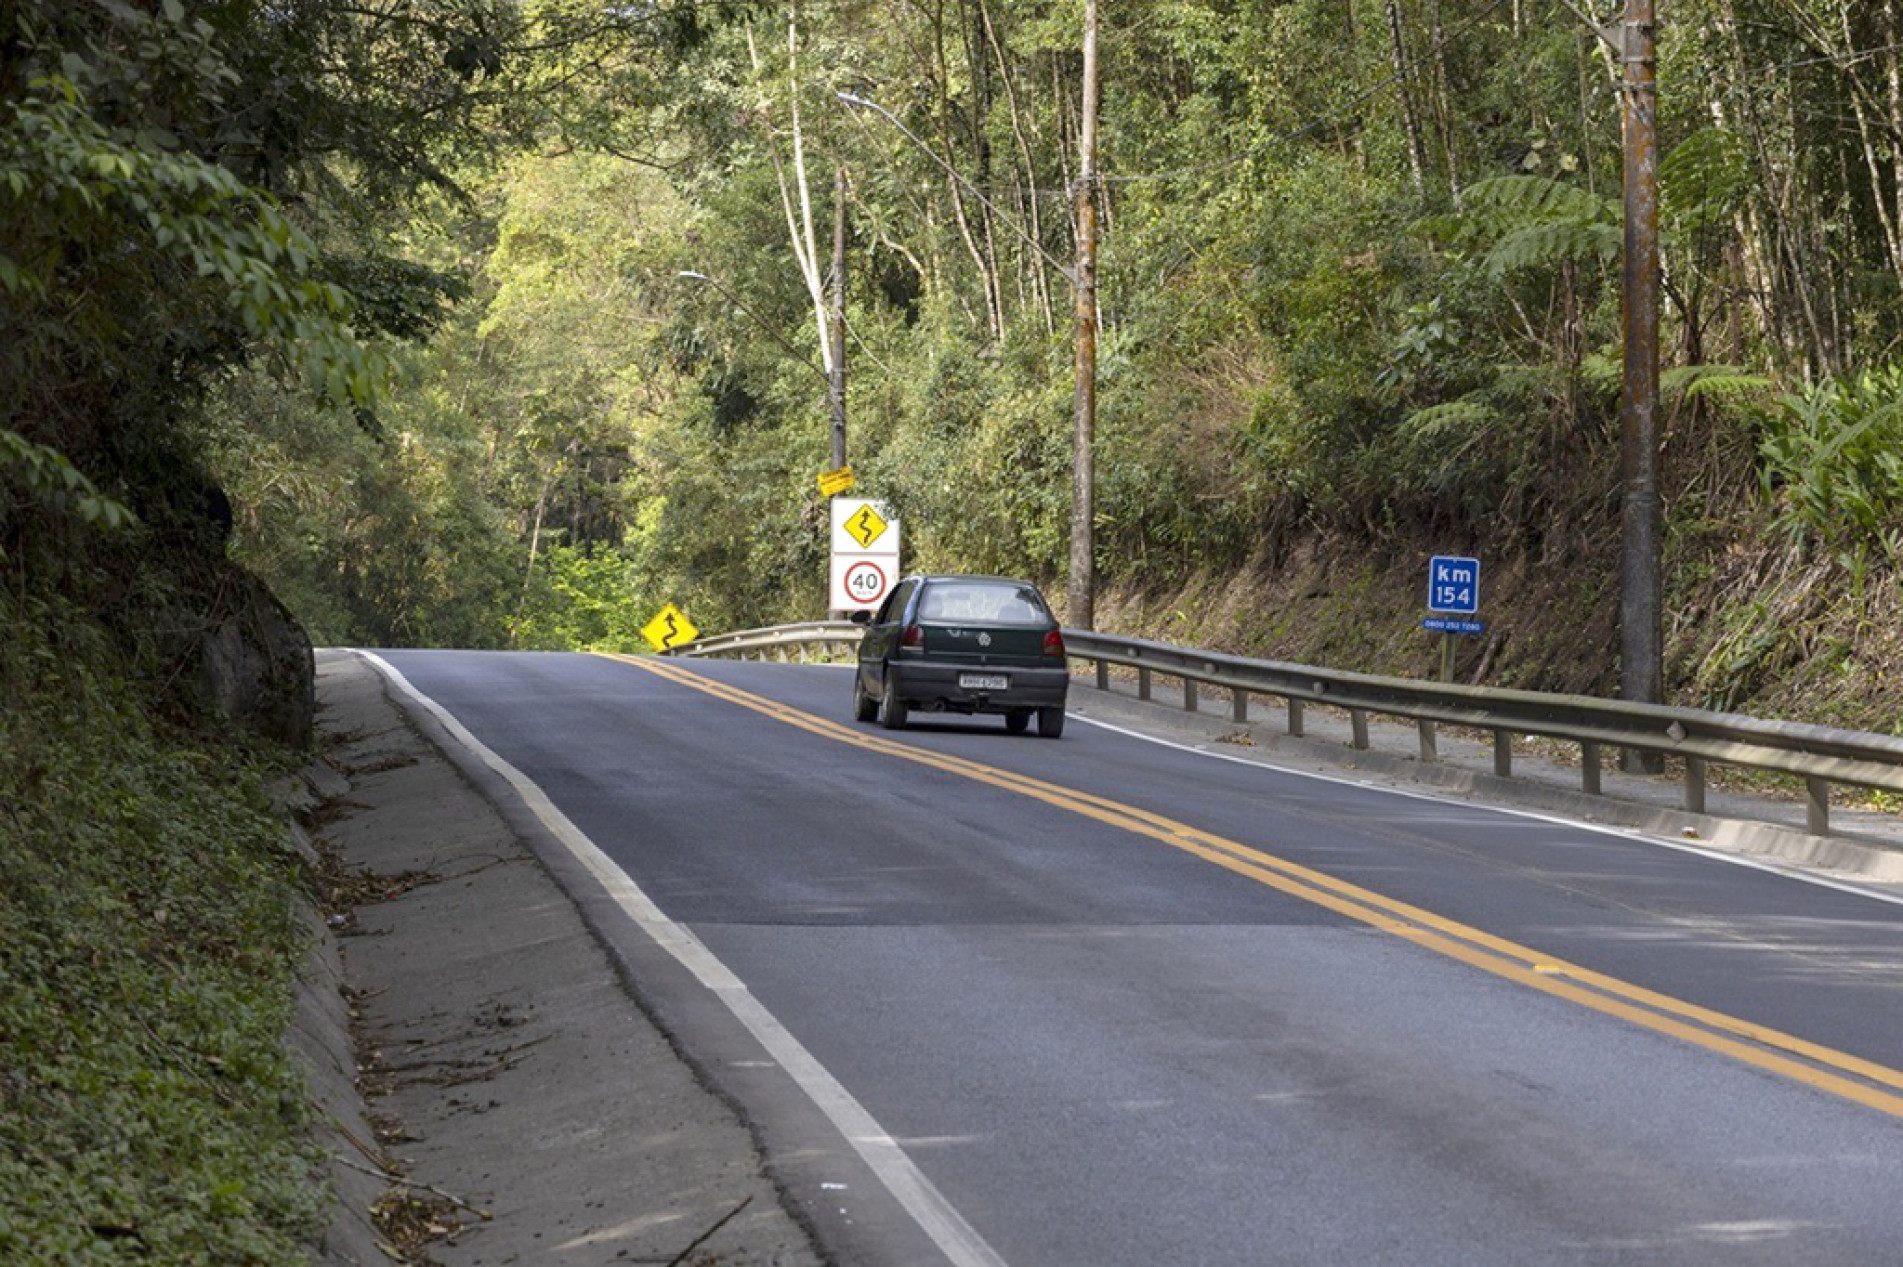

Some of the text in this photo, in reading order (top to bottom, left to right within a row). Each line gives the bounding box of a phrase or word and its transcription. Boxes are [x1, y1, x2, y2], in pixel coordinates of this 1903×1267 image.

[852, 573, 878, 590] 40
[1437, 565, 1471, 583] km
[1436, 586, 1471, 605] 154
